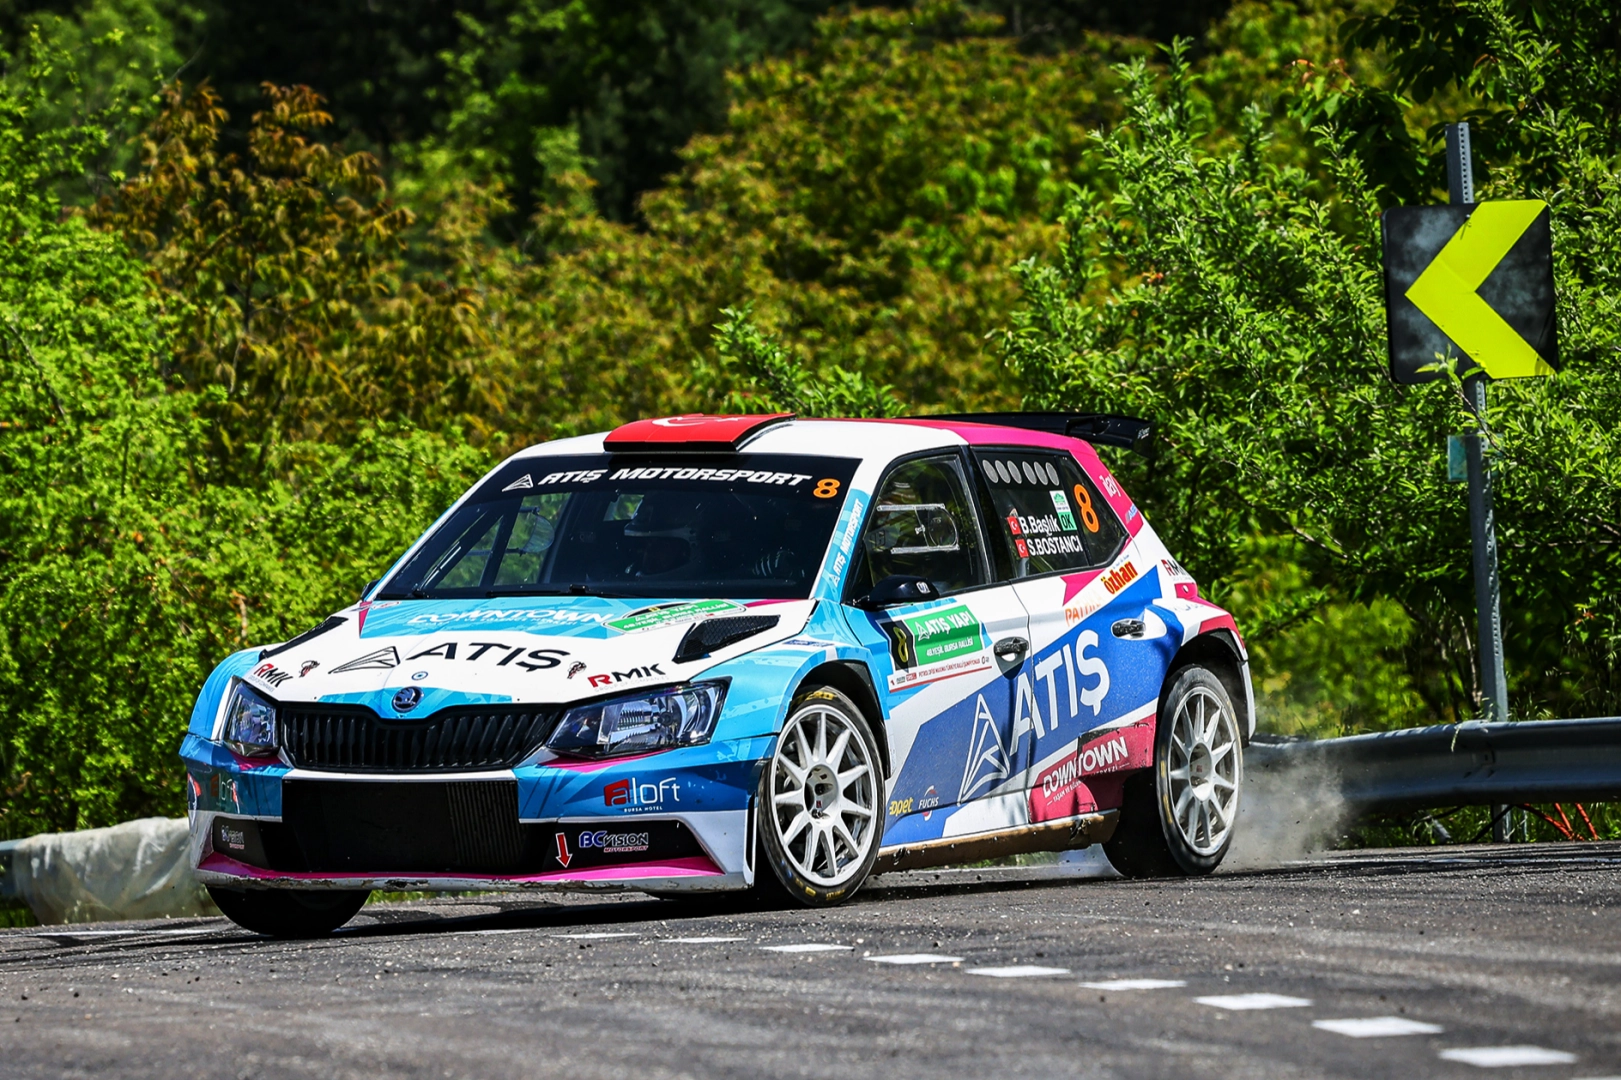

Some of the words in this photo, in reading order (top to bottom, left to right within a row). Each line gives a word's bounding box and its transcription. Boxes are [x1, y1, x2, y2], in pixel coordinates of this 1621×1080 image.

[538, 469, 608, 484] ATIŞ
[609, 467, 813, 486] MOTORSPORT
[813, 478, 841, 499] 8
[1073, 483, 1100, 533] 8
[1060, 514, 1075, 529] OK
[1026, 535, 1084, 556] S.BOSTANCI
[406, 609, 615, 624] DOWNTOWN
[924, 617, 951, 634] ATIŞ
[947, 611, 975, 629] YAPI
[893, 626, 909, 663] 8
[405, 642, 571, 672] ATIŞ
[253, 663, 294, 688] RMK
[587, 663, 666, 688] RMK
[1009, 629, 1111, 757] ATIŞ
[1042, 736, 1129, 798] DOWNTOWN
[603, 777, 681, 807] aloft
[918, 796, 940, 809] FUCHS
[603, 845, 649, 853] MOTORSPORT
